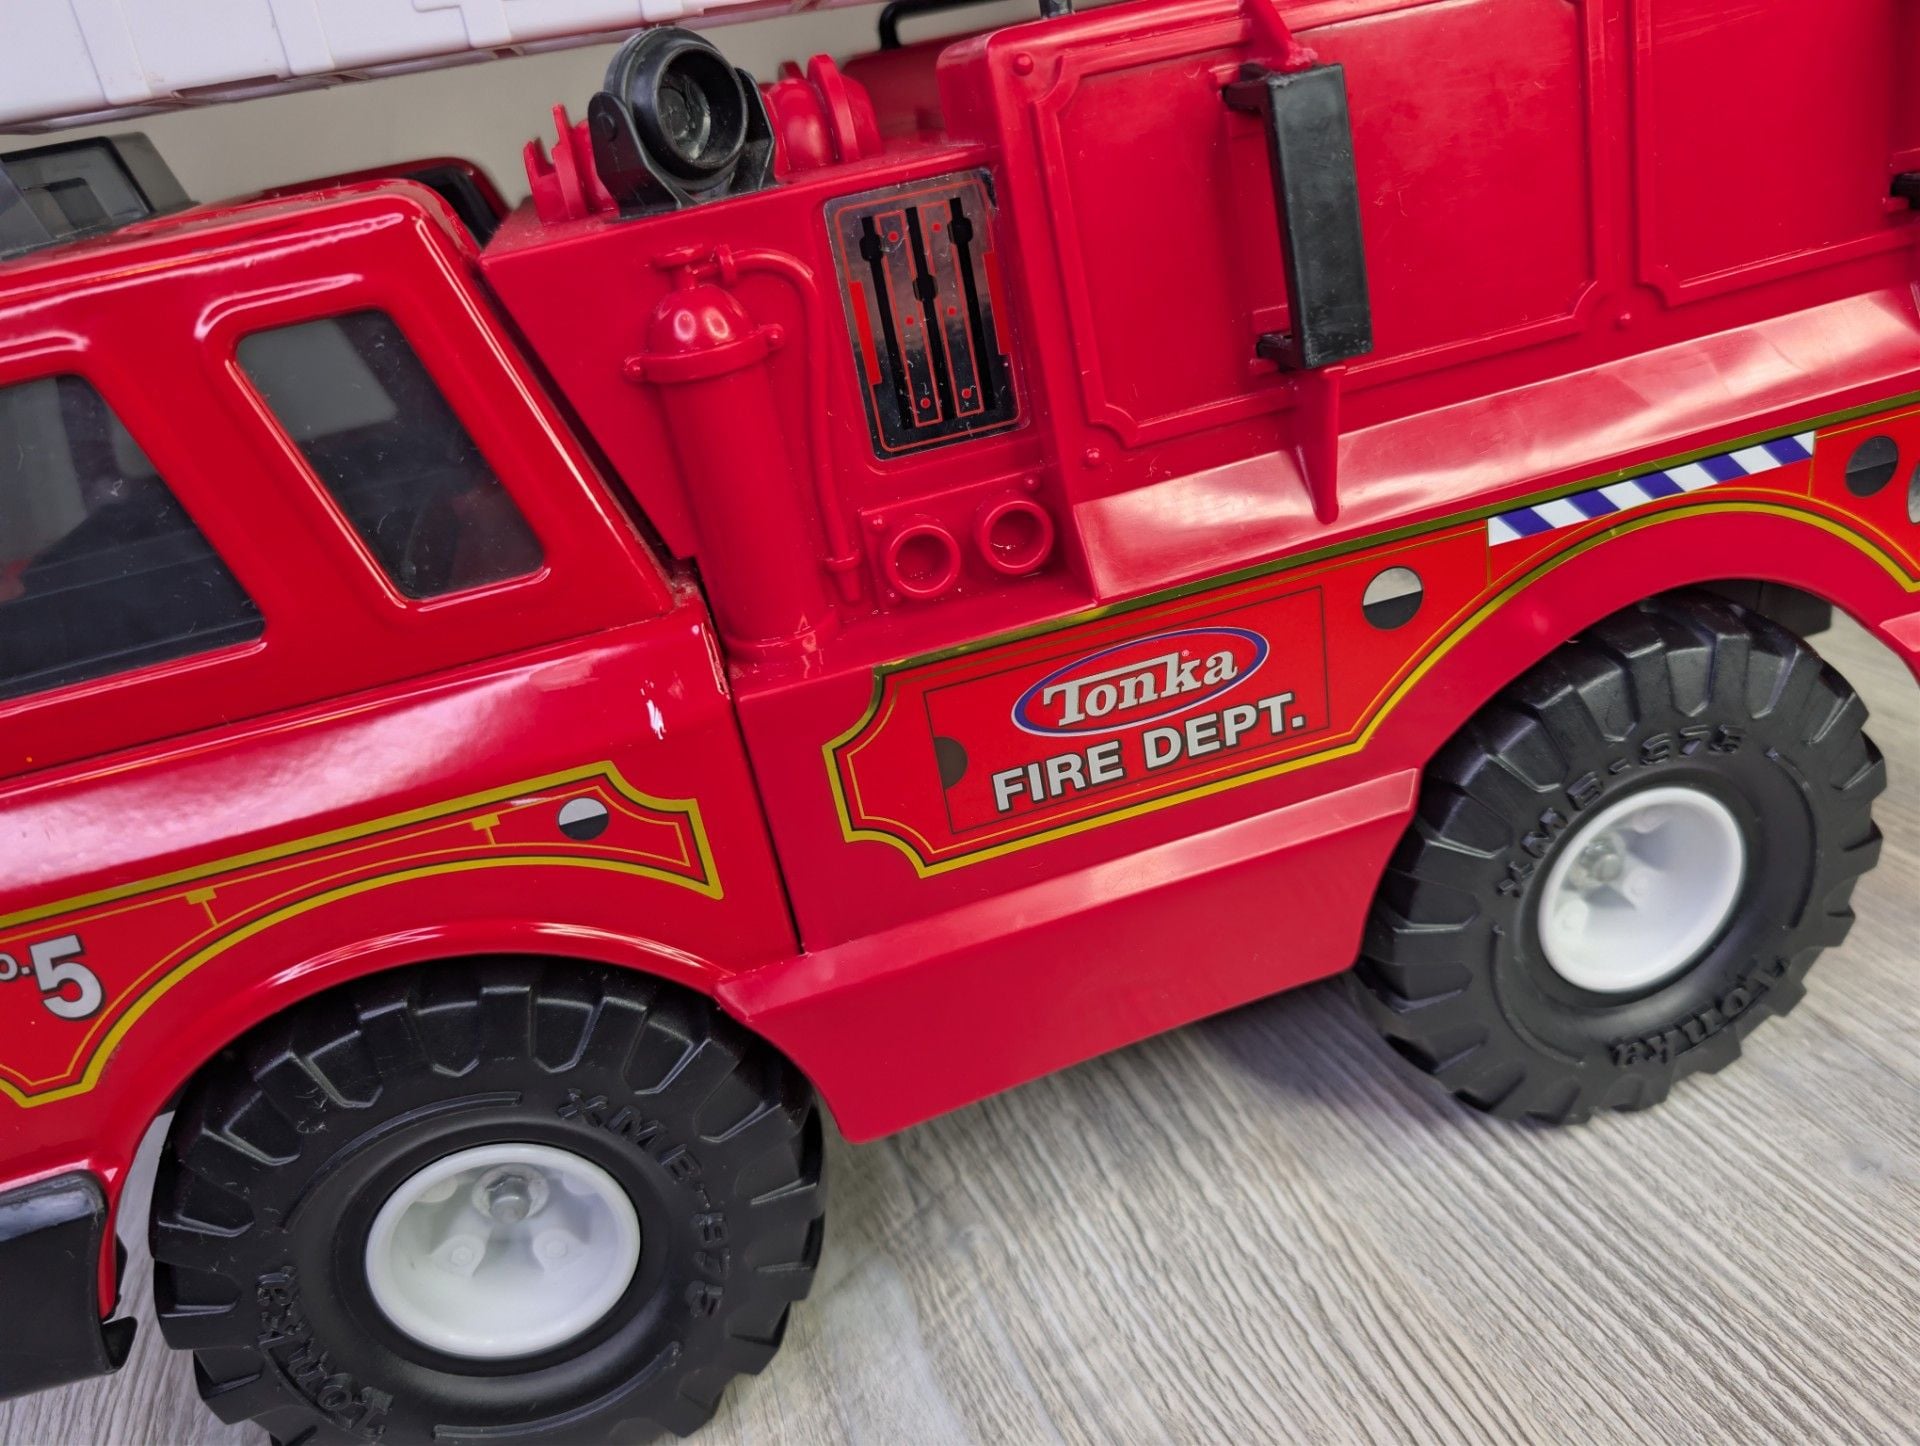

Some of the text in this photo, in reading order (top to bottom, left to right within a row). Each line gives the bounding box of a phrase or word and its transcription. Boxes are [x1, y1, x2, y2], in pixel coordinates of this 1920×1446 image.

[1043, 651, 1239, 726] Tonka
[992, 691, 1305, 812] FIRE DEPT.
